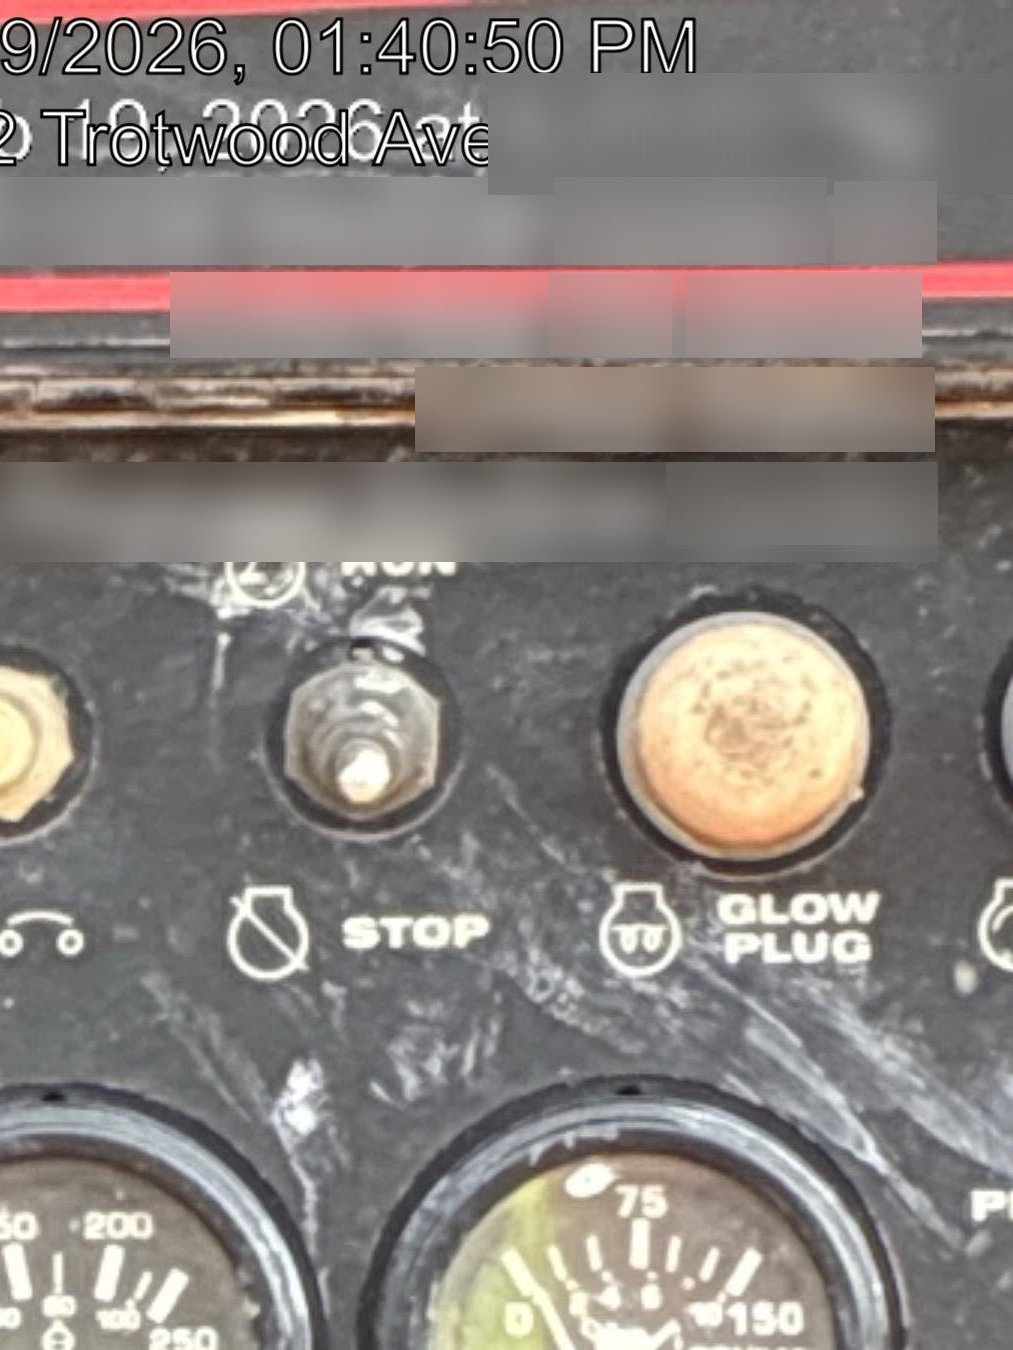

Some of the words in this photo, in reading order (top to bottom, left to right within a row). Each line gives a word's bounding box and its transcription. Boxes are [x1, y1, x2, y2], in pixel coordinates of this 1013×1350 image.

[717, 891, 881, 926] GLOW
[342, 914, 491, 951] STOP
[723, 930, 873, 965] PLUG
[615, 1184, 670, 1219] 75
[82, 1210, 154, 1241] 200
[504, 1302, 535, 1337] 0
[725, 1301, 805, 1337] 150
